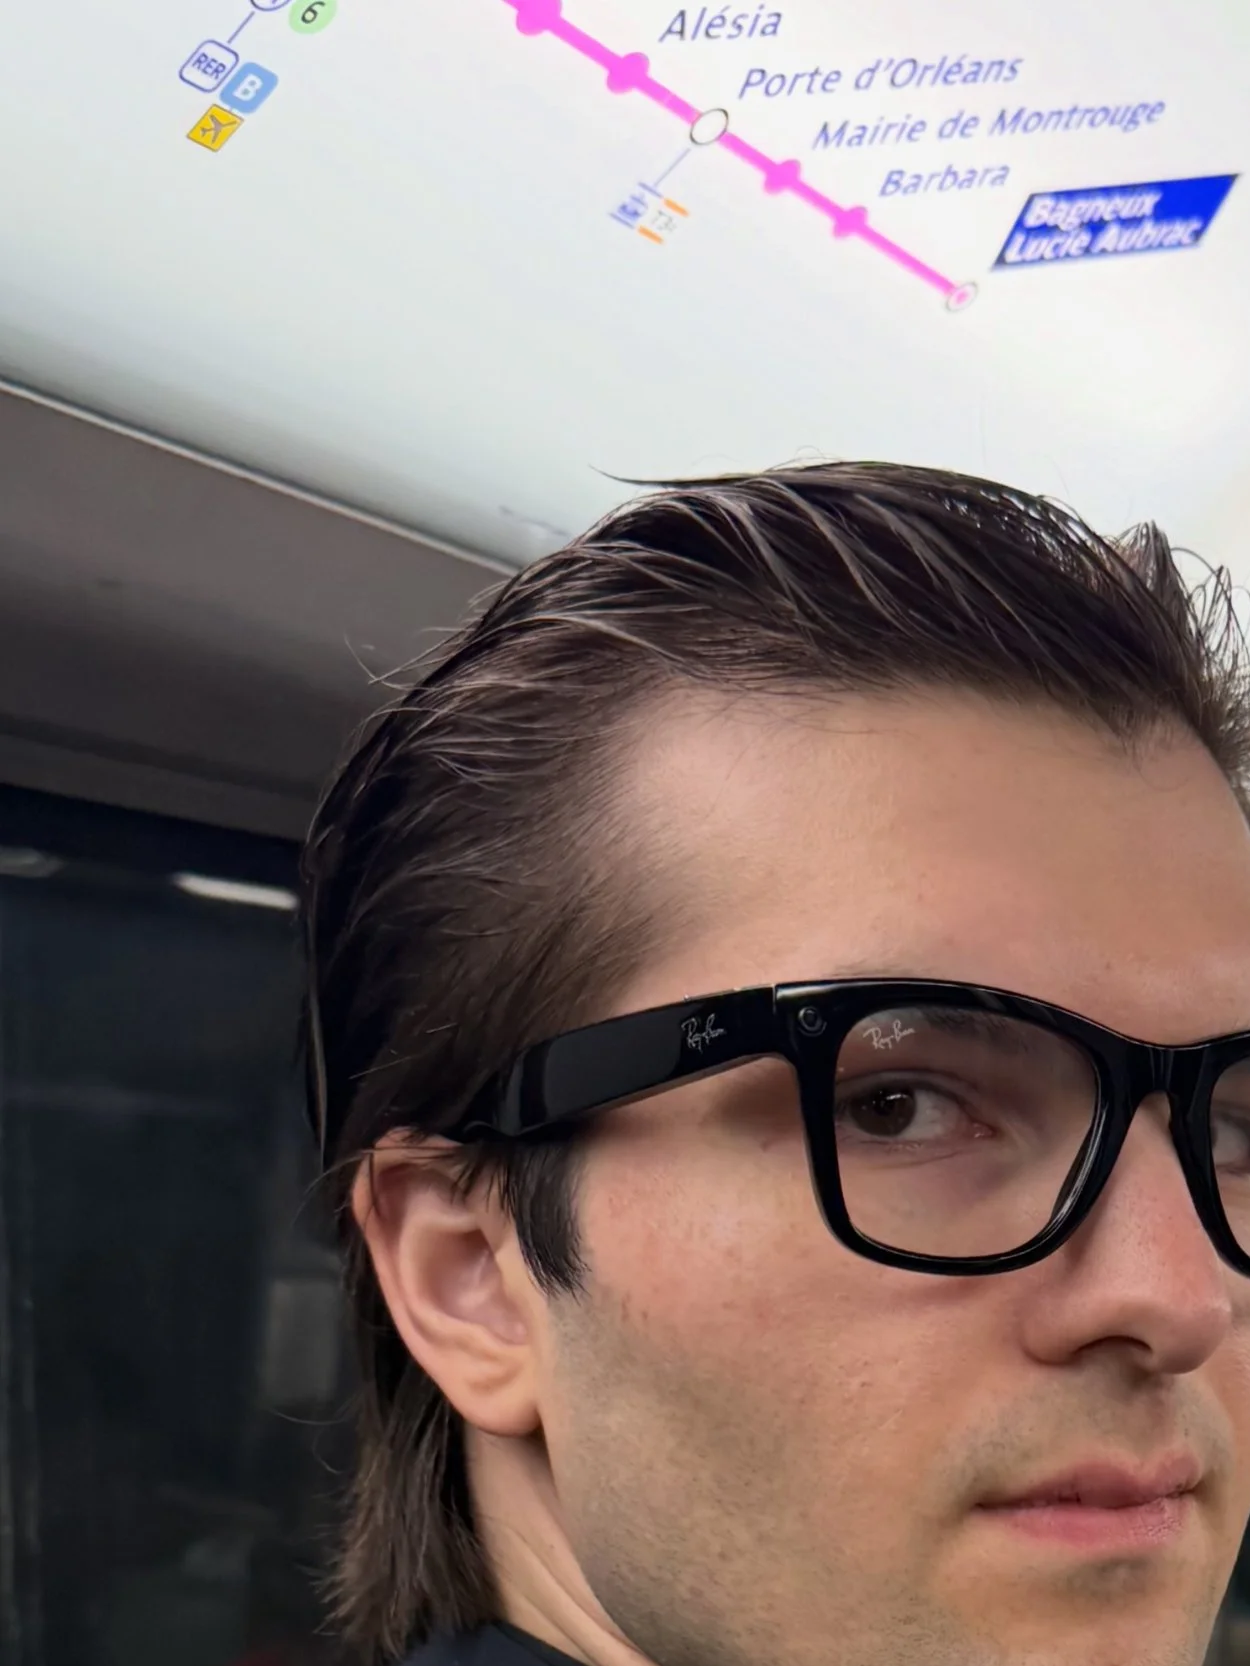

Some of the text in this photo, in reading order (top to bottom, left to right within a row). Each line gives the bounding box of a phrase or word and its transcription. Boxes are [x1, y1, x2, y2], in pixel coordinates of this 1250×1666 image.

[300, 1, 326, 25] 6
[657, 3, 784, 43] Alésia
[191, 52, 227, 80] RER
[737, 54, 1025, 101] Porte d'Orléans
[232, 73, 264, 102] B
[811, 99, 1167, 151] Mairie de Montrouge
[877, 163, 1013, 198] Barbara
[1023, 193, 1162, 231] Bagneux
[1004, 215, 1204, 264] Lucie Aubrac
